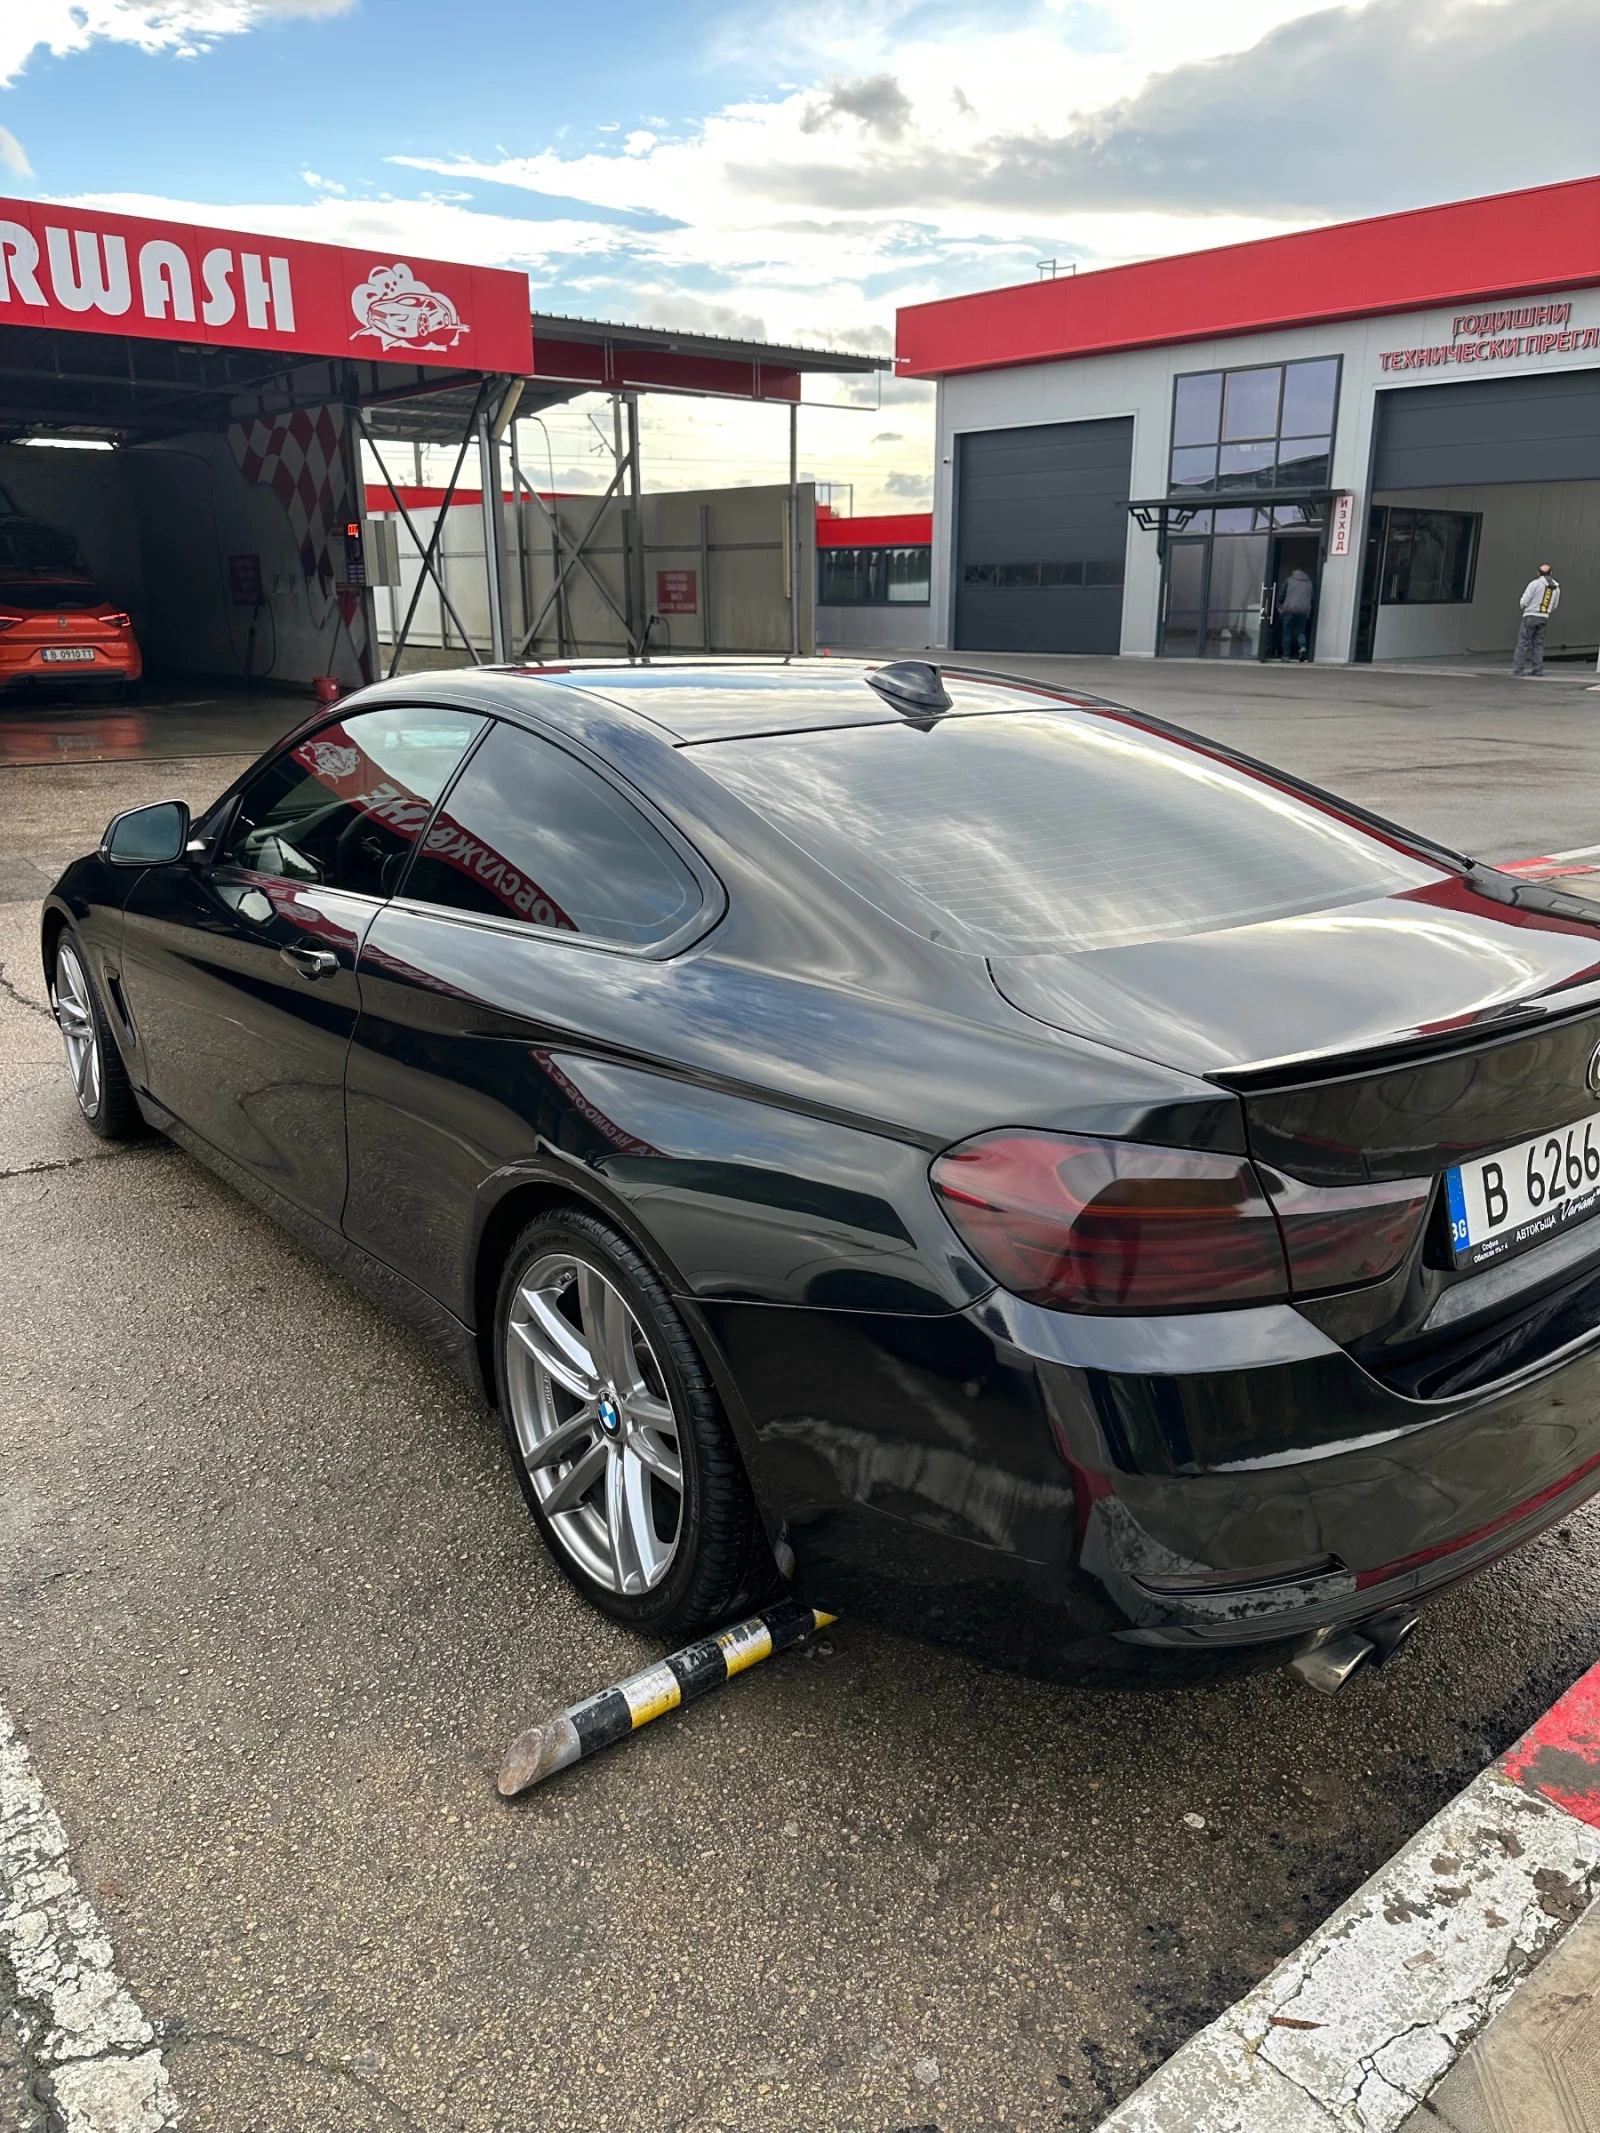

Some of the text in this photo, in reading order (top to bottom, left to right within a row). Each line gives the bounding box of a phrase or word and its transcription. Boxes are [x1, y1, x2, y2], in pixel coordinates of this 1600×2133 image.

[0, 219, 296, 333] RWASH
[1452, 302, 1570, 337] ГОДИШНИ
[1379, 327, 1600, 371] ТЕХНИЧЕСКИ ПРЕГЛ
[1335, 499, 1348, 551] ИЗХОД
[50, 650, 57, 659] B
[60, 650, 80, 659] 0910
[1482, 1122, 1600, 1228] B 6266
[1516, 1193, 1596, 1242] АВТОКЪЩА Variant
